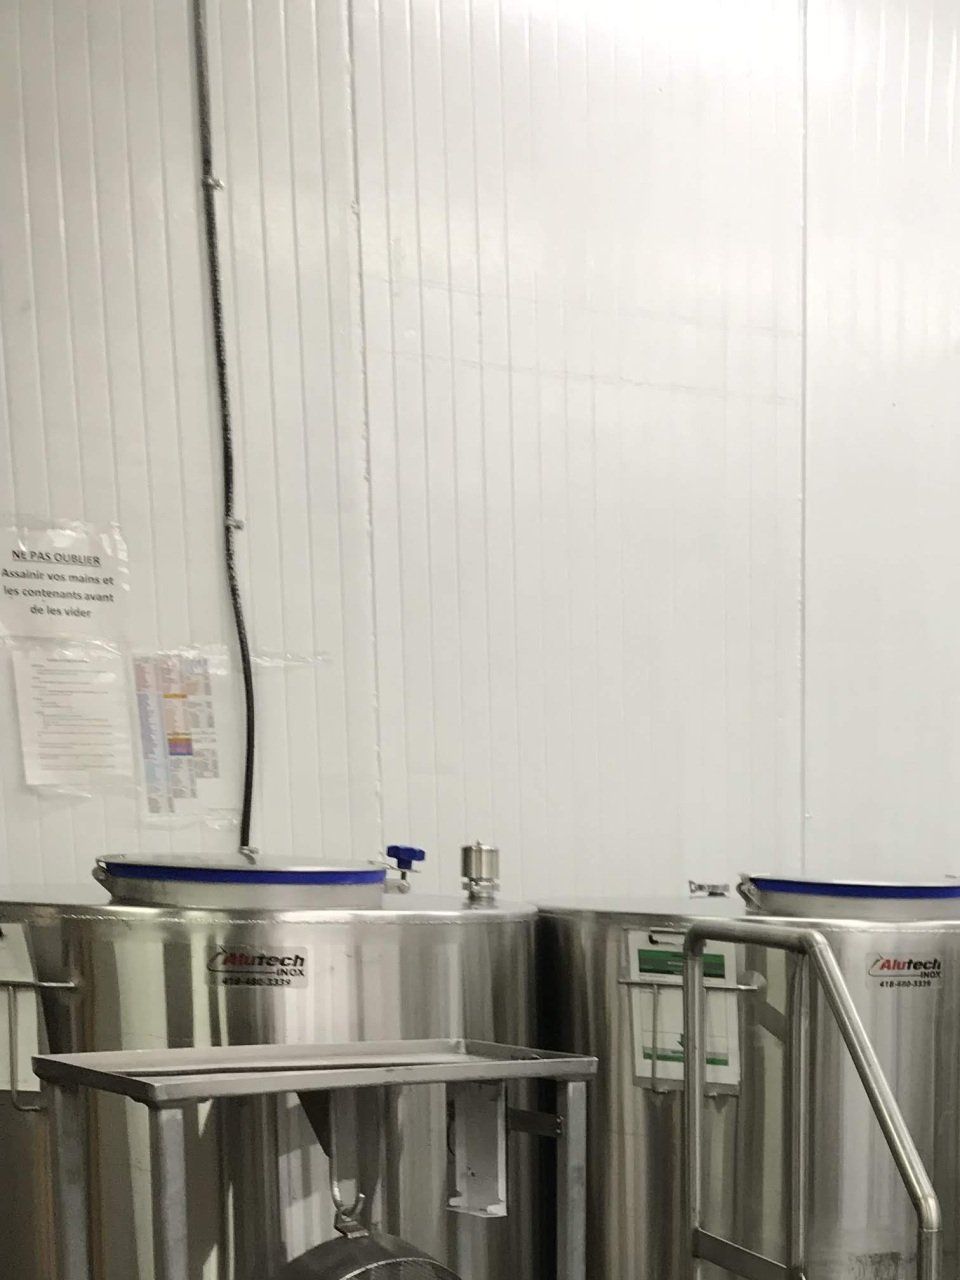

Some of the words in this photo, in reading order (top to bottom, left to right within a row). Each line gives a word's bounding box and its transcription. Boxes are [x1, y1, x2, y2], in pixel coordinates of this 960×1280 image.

[12, 550, 27, 561] NE
[30, 551, 51, 561] PAS
[53, 553, 101, 566] OUBLIER
[1, 568, 44, 580] Assainir
[46, 572, 66, 582] vos
[69, 573, 100, 584] mains
[103, 576, 114, 585] et
[4, 585, 19, 596] les
[22, 588, 82, 600] contenants
[84, 592, 114, 602] avant
[30, 604, 44, 615] de
[46, 605, 62, 616] les
[64, 606, 92, 618] vider
[880, 958, 942, 971] Alutech
[276, 968, 305, 977] INOX
